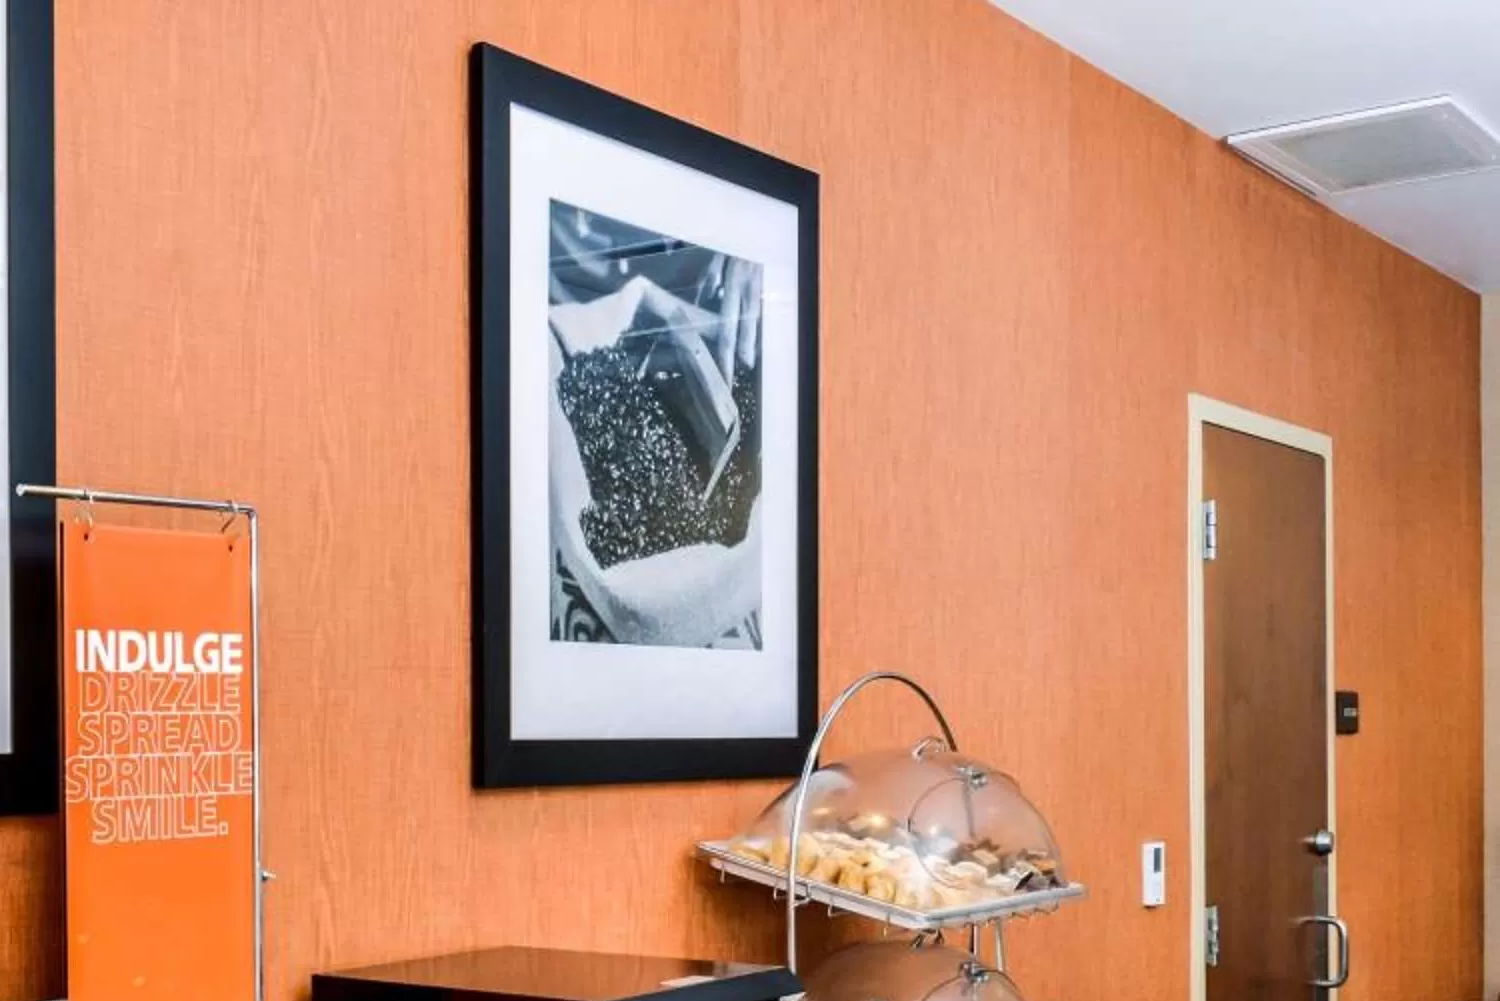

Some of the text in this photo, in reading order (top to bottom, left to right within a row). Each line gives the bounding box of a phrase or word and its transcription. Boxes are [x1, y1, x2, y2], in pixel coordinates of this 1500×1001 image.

[75, 629, 243, 673] INDULGE
[79, 671, 241, 713] DRIZZLE
[77, 711, 242, 757] SPREAD
[65, 751, 253, 803] SPRINKLE
[91, 794, 229, 844] SMILE.
